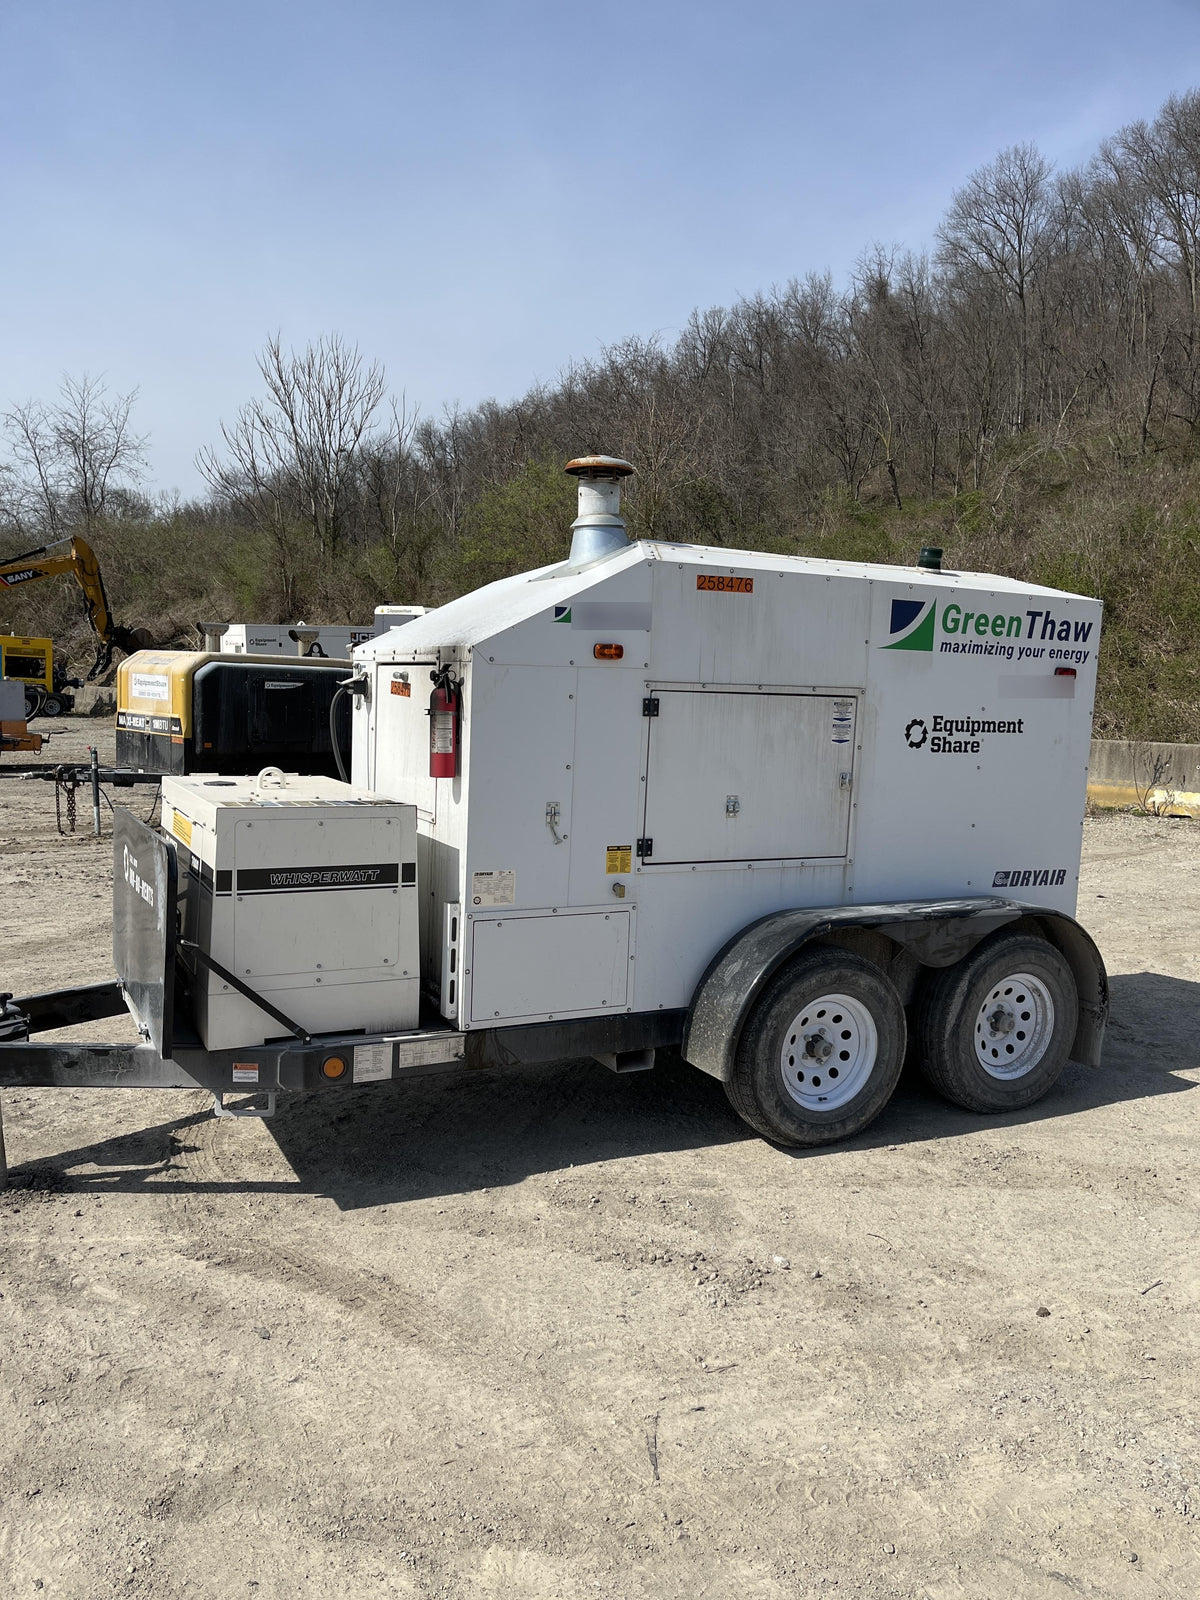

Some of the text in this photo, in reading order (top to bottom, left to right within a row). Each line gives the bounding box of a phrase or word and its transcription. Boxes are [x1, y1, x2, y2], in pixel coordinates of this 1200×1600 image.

[7, 570, 33, 583] SANY
[696, 575, 753, 593] 258476
[940, 640, 1090, 664] maximizing your energy
[932, 715, 1024, 736] Equipment
[930, 736, 980, 753] Share
[270, 869, 381, 885] WHISPERWATT
[1009, 869, 1067, 887] DRYAIR
